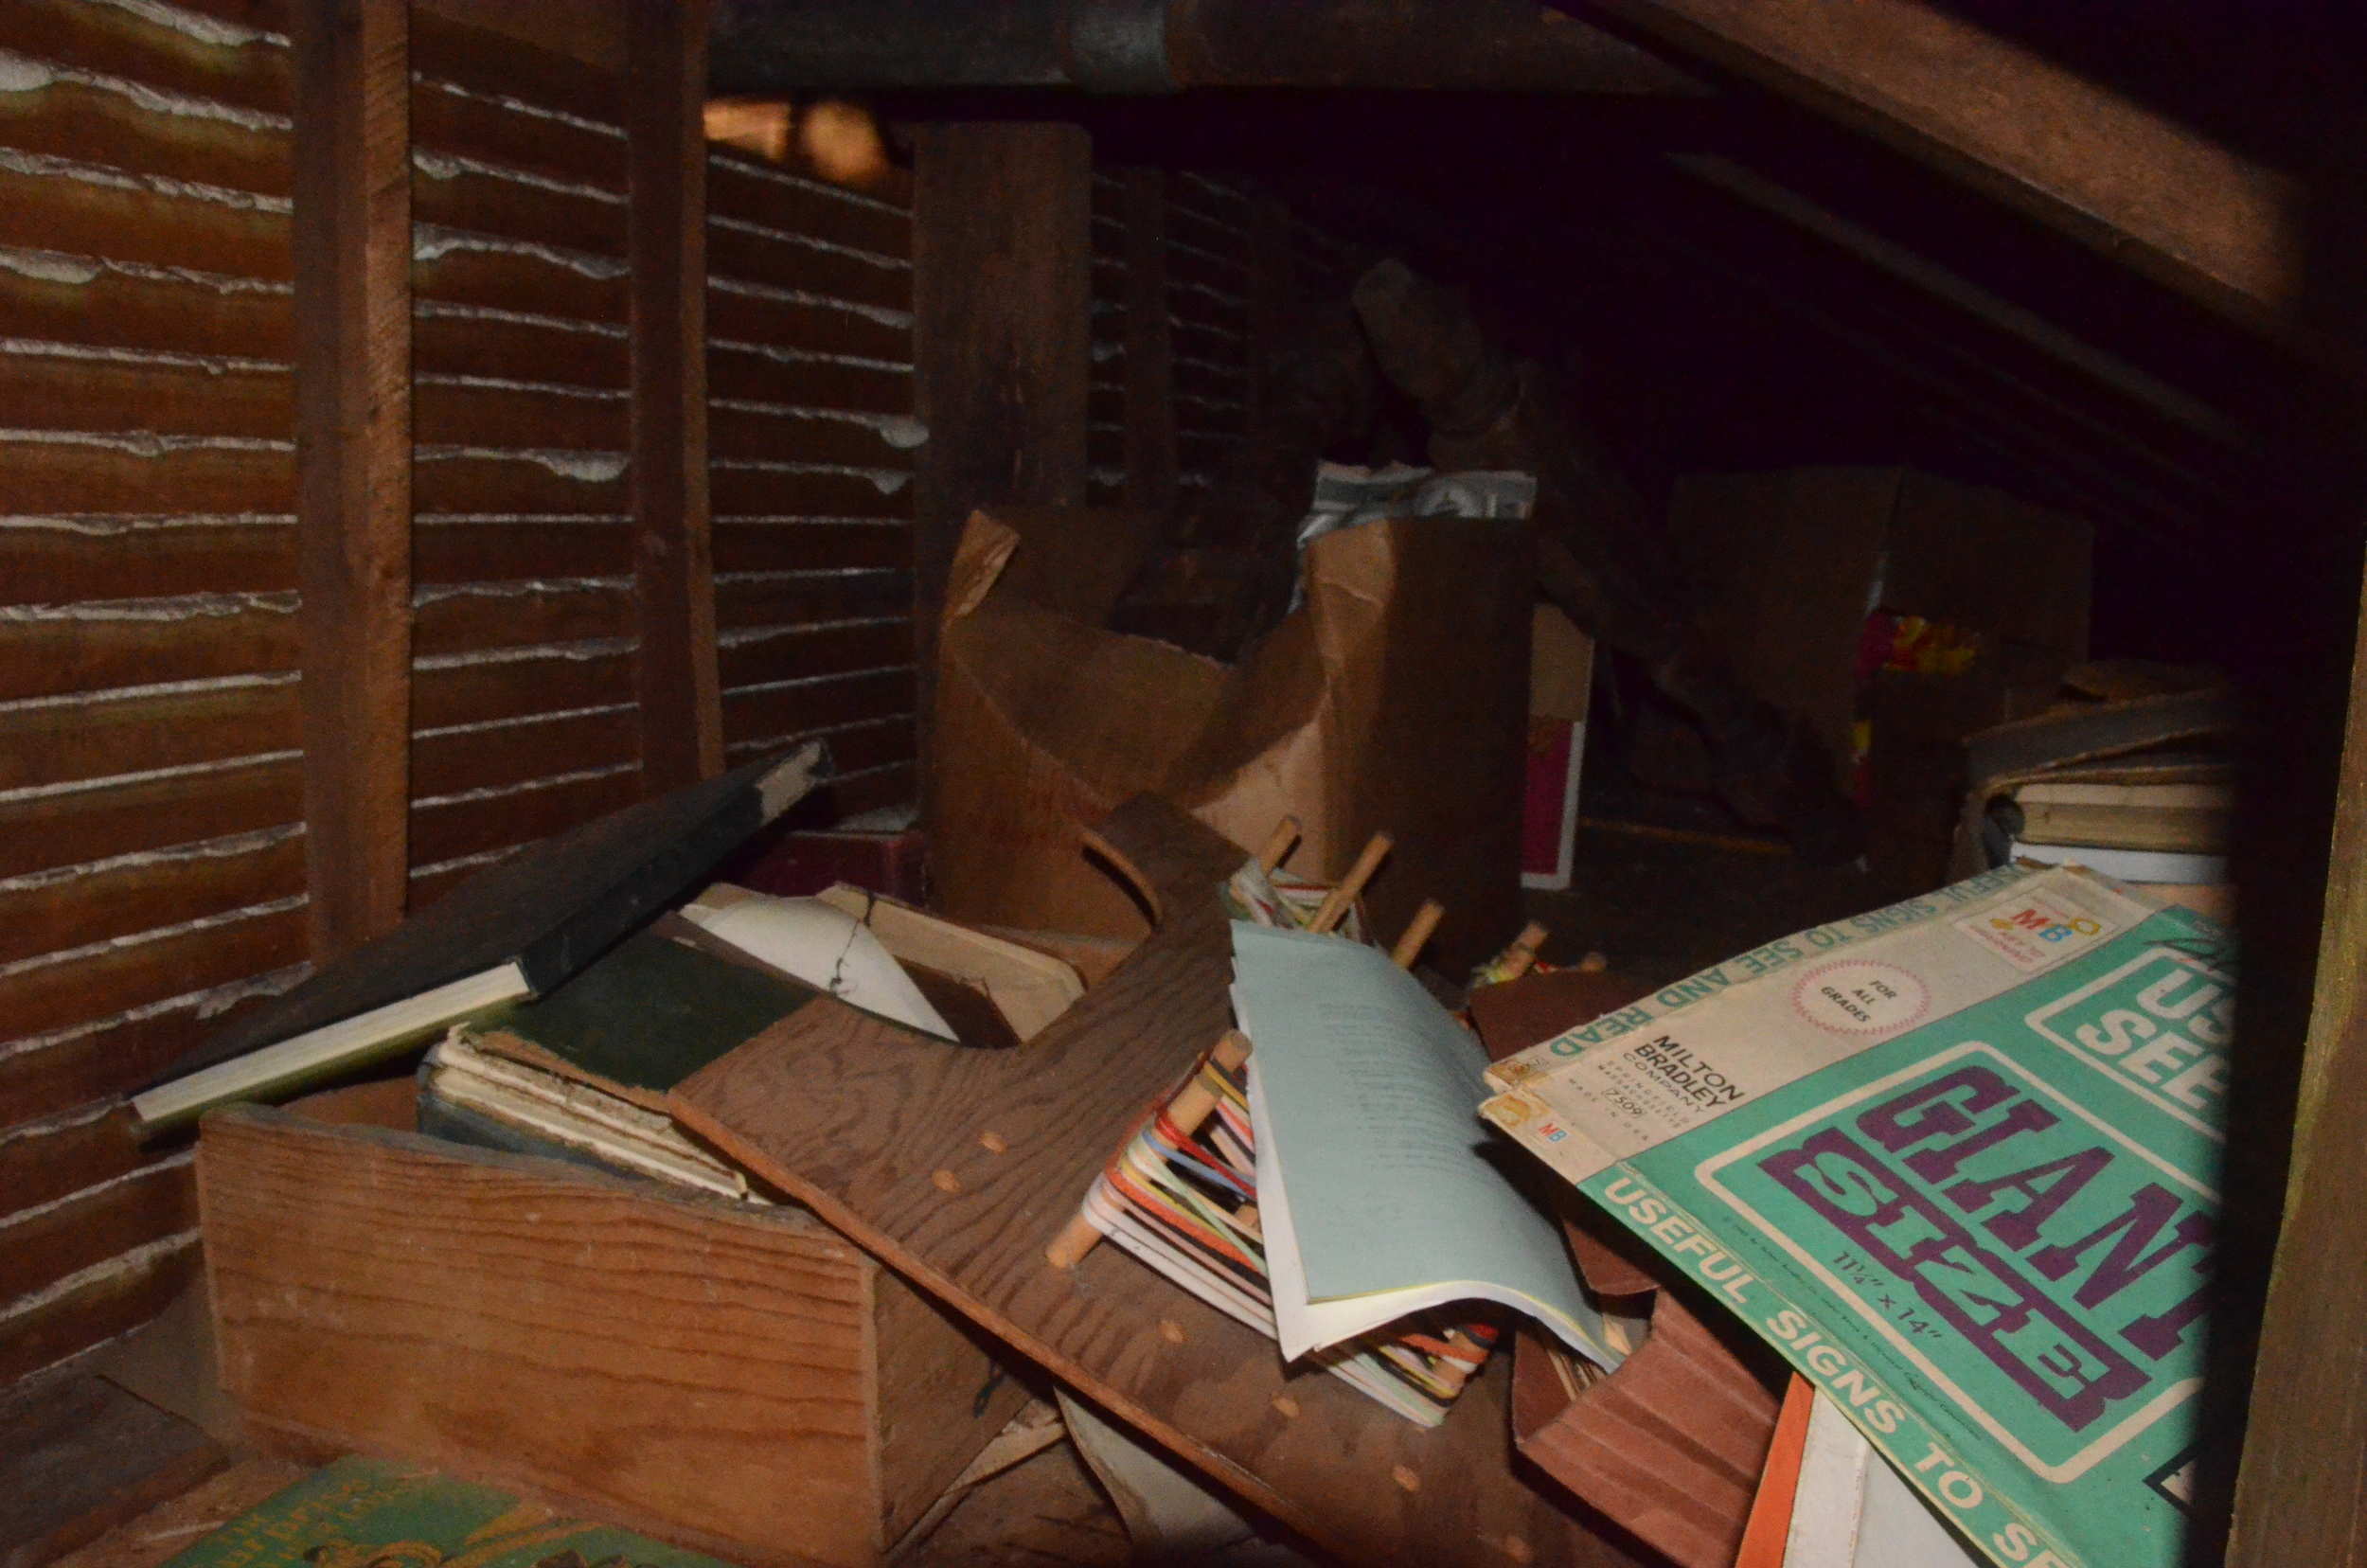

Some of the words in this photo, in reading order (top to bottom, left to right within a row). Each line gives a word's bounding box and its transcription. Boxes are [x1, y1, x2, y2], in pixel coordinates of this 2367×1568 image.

[1806, 925, 1853, 948] TO
[1850, 900, 1938, 935] SIGNS
[1733, 940, 1803, 973] SEE
[1655, 970, 1730, 1008] AND
[1819, 984, 1871, 1025] GRADES
[1849, 986, 1877, 1006] ALL
[1868, 979, 1897, 1002] FOR
[1549, 1006, 1655, 1060] READ
[1622, 1052, 1706, 1114] COMPANY
[1633, 1042, 1727, 1109] BRADLEY
[1653, 1034, 1746, 1102] MILTON
[1568, 1078, 1598, 1103] MADE
[1597, 1064, 1682, 1130] MASSACHUSETTS
[1606, 1089, 1643, 1117] 7509
[1607, 1060, 1690, 1125] SPRINGFIELD
[1538, 1121, 1568, 1143] MB
[1788, 1147, 2115, 1403] SIZE
[1604, 1177, 1754, 1305] USEFUL
[1766, 1309, 1906, 1434] SIGNS
[1912, 1441, 1984, 1509] TO
